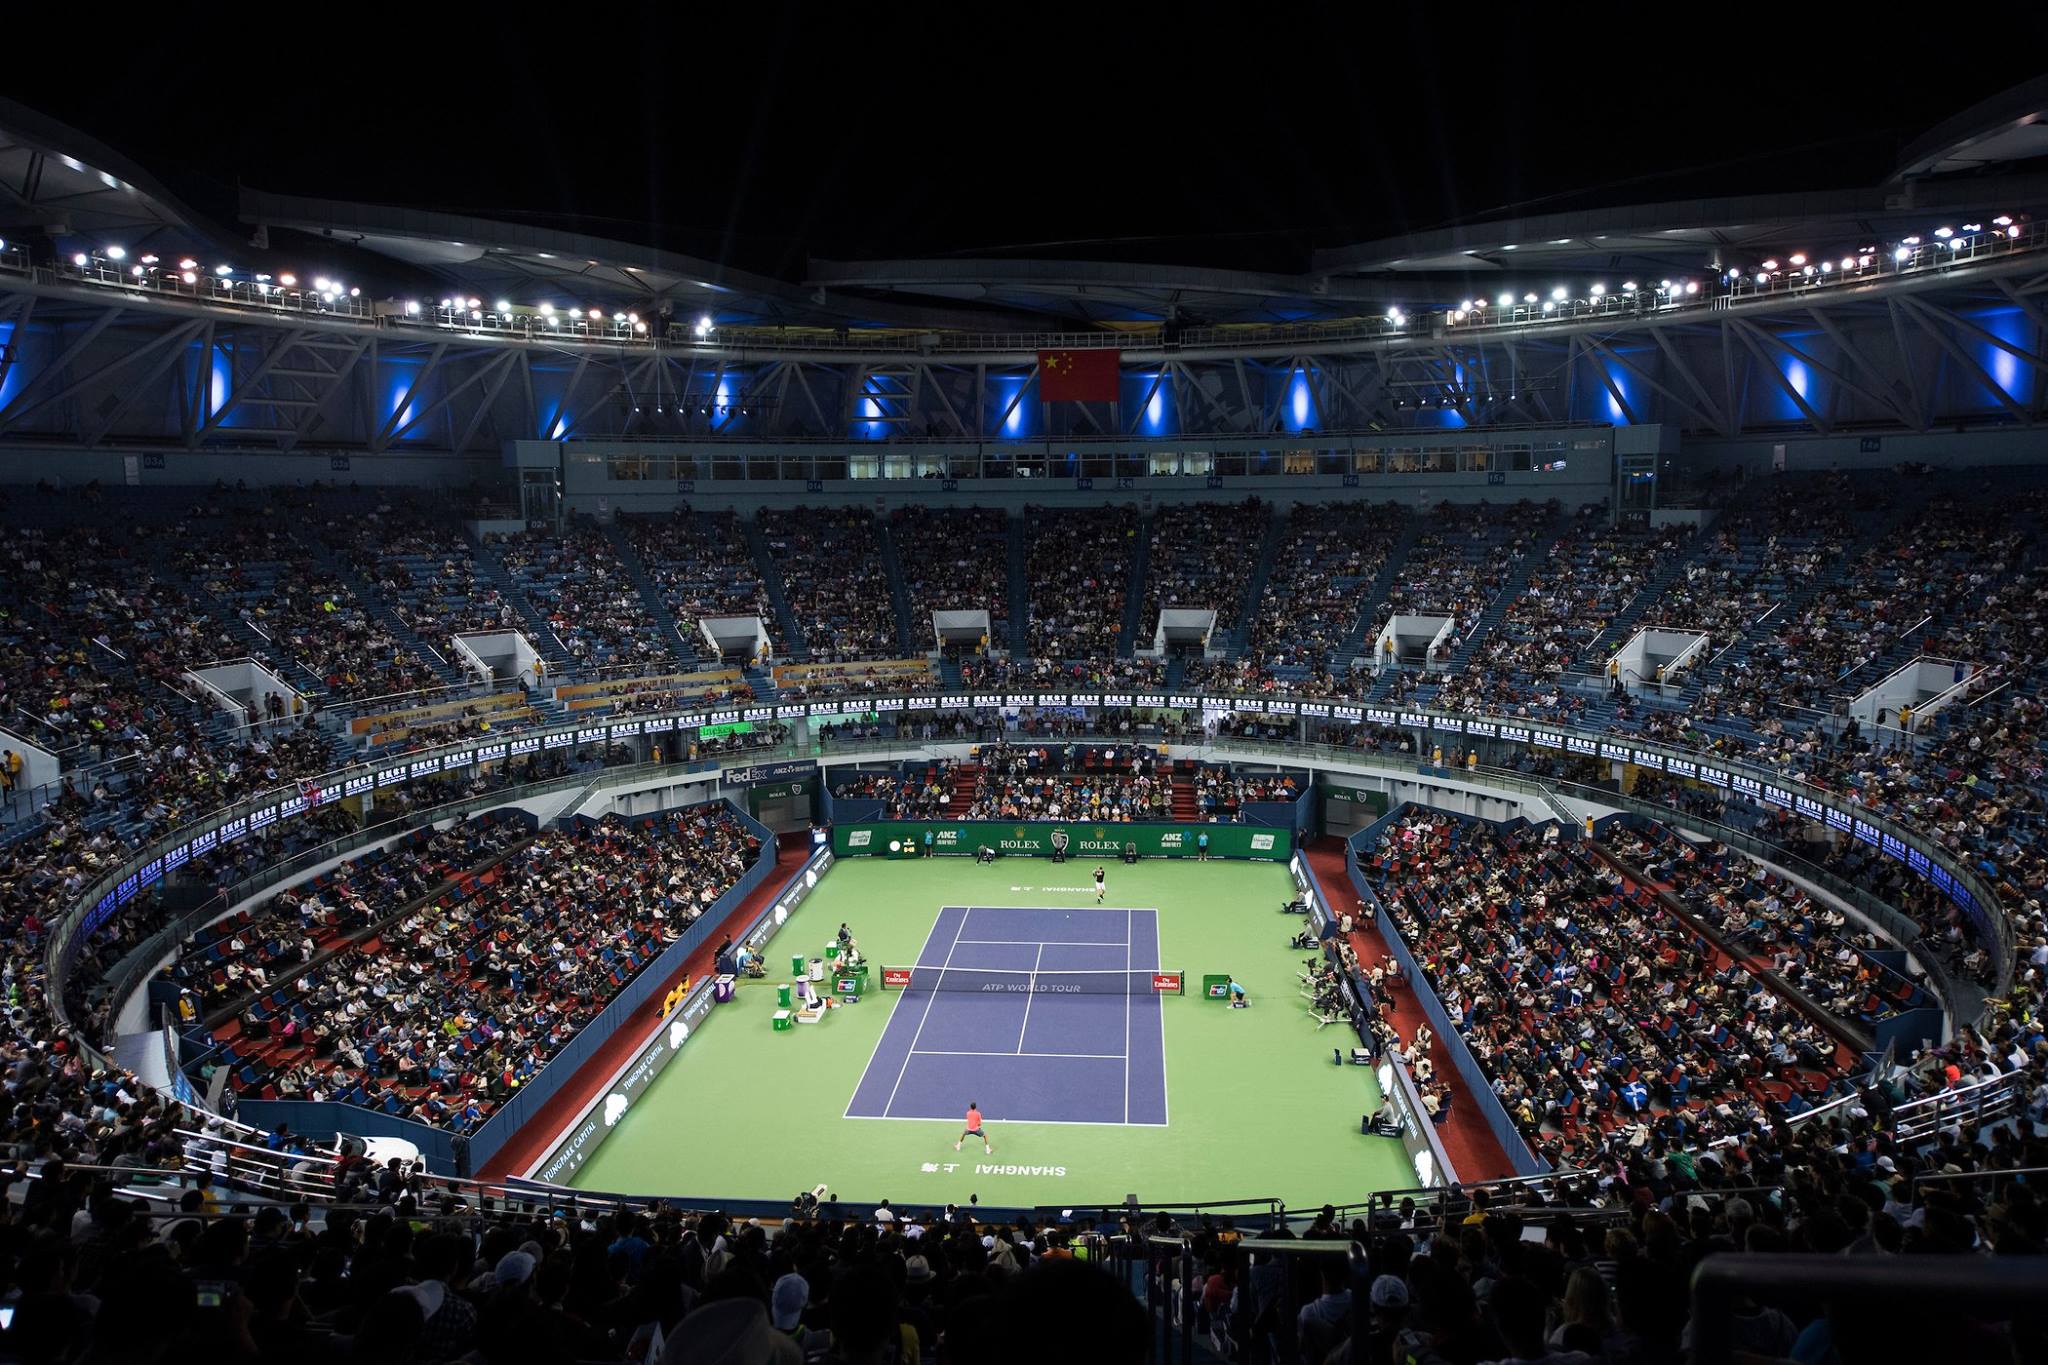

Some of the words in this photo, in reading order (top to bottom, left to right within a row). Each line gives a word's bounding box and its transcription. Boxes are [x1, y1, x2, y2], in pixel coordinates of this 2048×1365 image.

[726, 767, 768, 784] FedEx
[937, 831, 957, 839] ANZ
[1161, 833, 1182, 841] ANZ
[1000, 840, 1040, 849] ROLEX
[1080, 841, 1120, 850] ROLEX
[1007, 984, 1047, 992] WORLD
[543, 1146, 575, 1183] YUNGPARK
[573, 1121, 597, 1148] CAPITAL
[975, 1164, 1066, 1177] SHANGHAI
